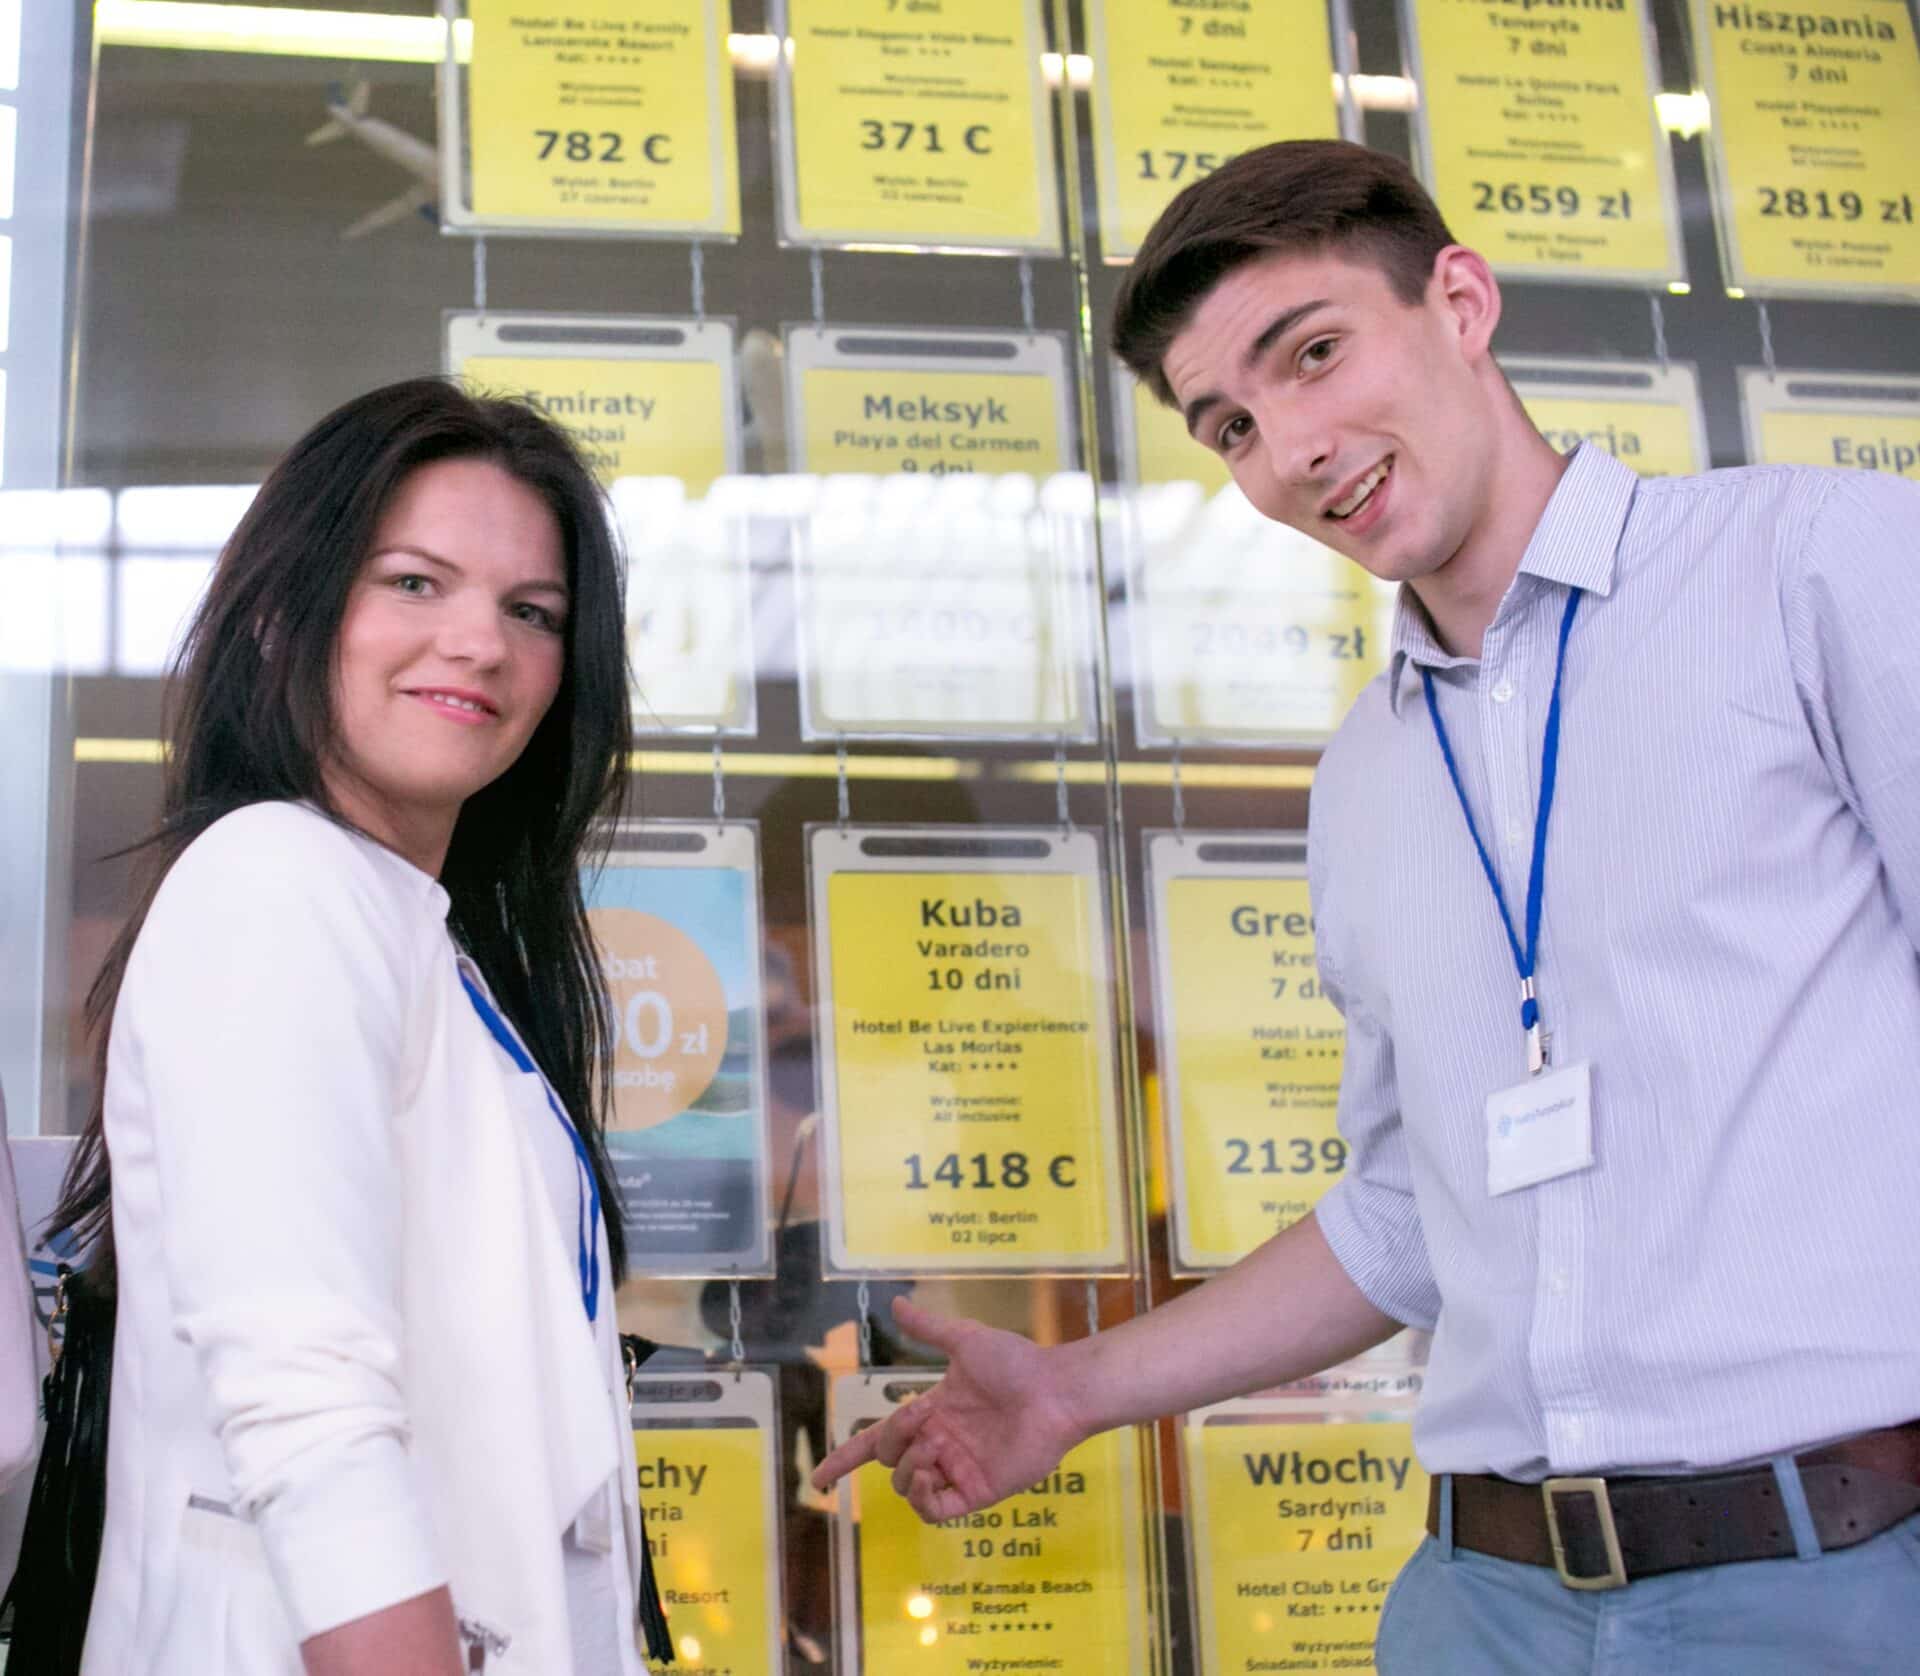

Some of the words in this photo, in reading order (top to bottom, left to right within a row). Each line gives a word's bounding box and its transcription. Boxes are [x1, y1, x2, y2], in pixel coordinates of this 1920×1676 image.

[1203, 18, 1245, 38] dni
[1714, 4, 1896, 42] Hiszpania
[1808, 65, 1847, 84] dni
[533, 130, 625, 162] 782
[860, 120, 944, 153] 371
[1473, 181, 1580, 216] 2659
[1759, 187, 1863, 221] 2819
[863, 395, 1008, 429] Meksyk
[834, 430, 898, 452] Playa
[906, 432, 941, 449] del
[950, 434, 1040, 452] Carmen
[1832, 437, 1920, 473] Egip
[1328, 625, 1367, 660] zł
[921, 898, 1022, 928] Kuba
[917, 939, 1030, 959] Varadero
[1272, 950, 1316, 967] Kre
[928, 968, 963, 990] 10
[974, 967, 1021, 990] dni
[1271, 978, 1287, 999] 7
[853, 1019, 901, 1033] Hotel
[909, 1020, 931, 1033] Be
[938, 1019, 976, 1033] Live
[680, 1025, 708, 1055] zł
[923, 1040, 954, 1054] Las
[929, 1060, 961, 1073] Kat:
[1225, 1138, 1347, 1174] 2139
[903, 1152, 1030, 1190] 1418
[1048, 1154, 1077, 1188] €
[929, 1211, 981, 1226] Wylot:
[988, 1211, 1038, 1224] Berlin
[951, 1230, 973, 1243] 02
[978, 1229, 1017, 1247] lipca
[1244, 1450, 1411, 1490] Włochy
[1012, 1508, 1057, 1528] Lak
[1278, 1498, 1385, 1520] Sardynia
[963, 1540, 993, 1558] 10
[1002, 1538, 1041, 1557] dni
[1297, 1530, 1314, 1551] 7
[1327, 1528, 1372, 1551] dni
[665, 1589, 729, 1604] Resort
[921, 1582, 967, 1595] Hotel
[973, 1582, 1035, 1595] Kamala
[1042, 1580, 1092, 1594] Beach
[1238, 1583, 1286, 1597] Hotel
[1293, 1581, 1333, 1595] Club
[1341, 1580, 1360, 1593] Le
[973, 1601, 1028, 1614] Resort
[1288, 1604, 1325, 1617] Kat:
[947, 1622, 981, 1635] Kat:
[967, 1658, 1062, 1672] Wyżywienie:
